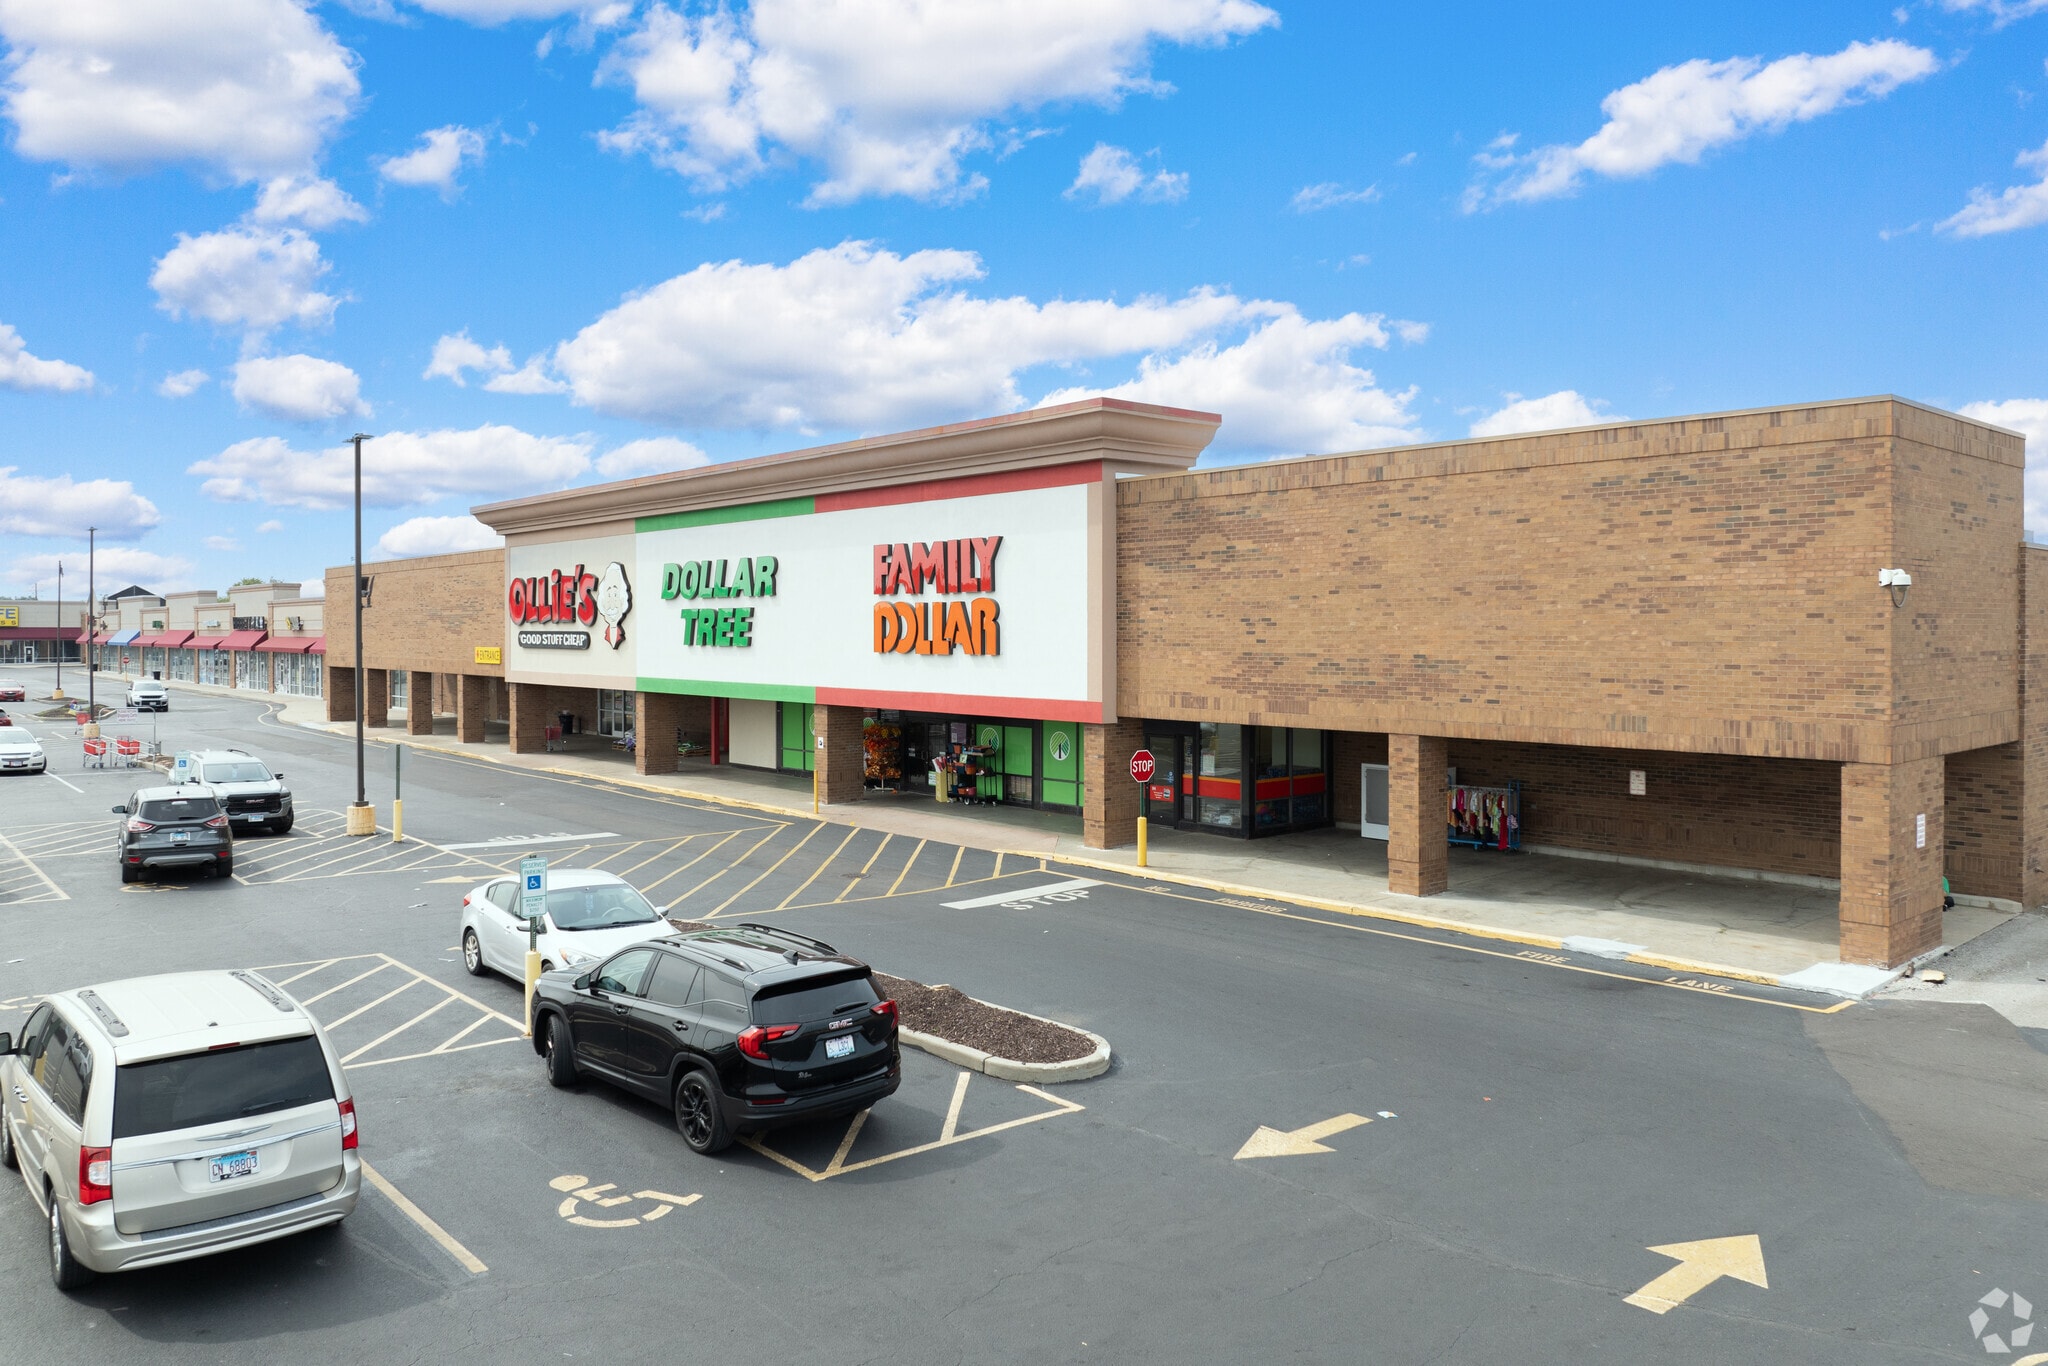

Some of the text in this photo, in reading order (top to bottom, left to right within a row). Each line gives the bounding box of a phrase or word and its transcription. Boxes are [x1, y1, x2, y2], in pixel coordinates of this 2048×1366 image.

[873, 535, 1003, 595] FAMILY
[661, 555, 778, 600] DOLLAR
[681, 607, 755, 647] TREE
[873, 597, 1001, 656] DOLLAR
[542, 633, 564, 645] STUFF
[479, 649, 500, 661] ENTRANCE
[1132, 760, 1153, 773] STOP
[522, 861, 546, 869] RESERVED
[1001, 890, 1090, 911] STOP
[1516, 950, 1571, 964] FIRE
[1664, 976, 1734, 993] LANE
[828, 1018, 853, 1030] GMC
[212, 1163, 223, 1177] CN
